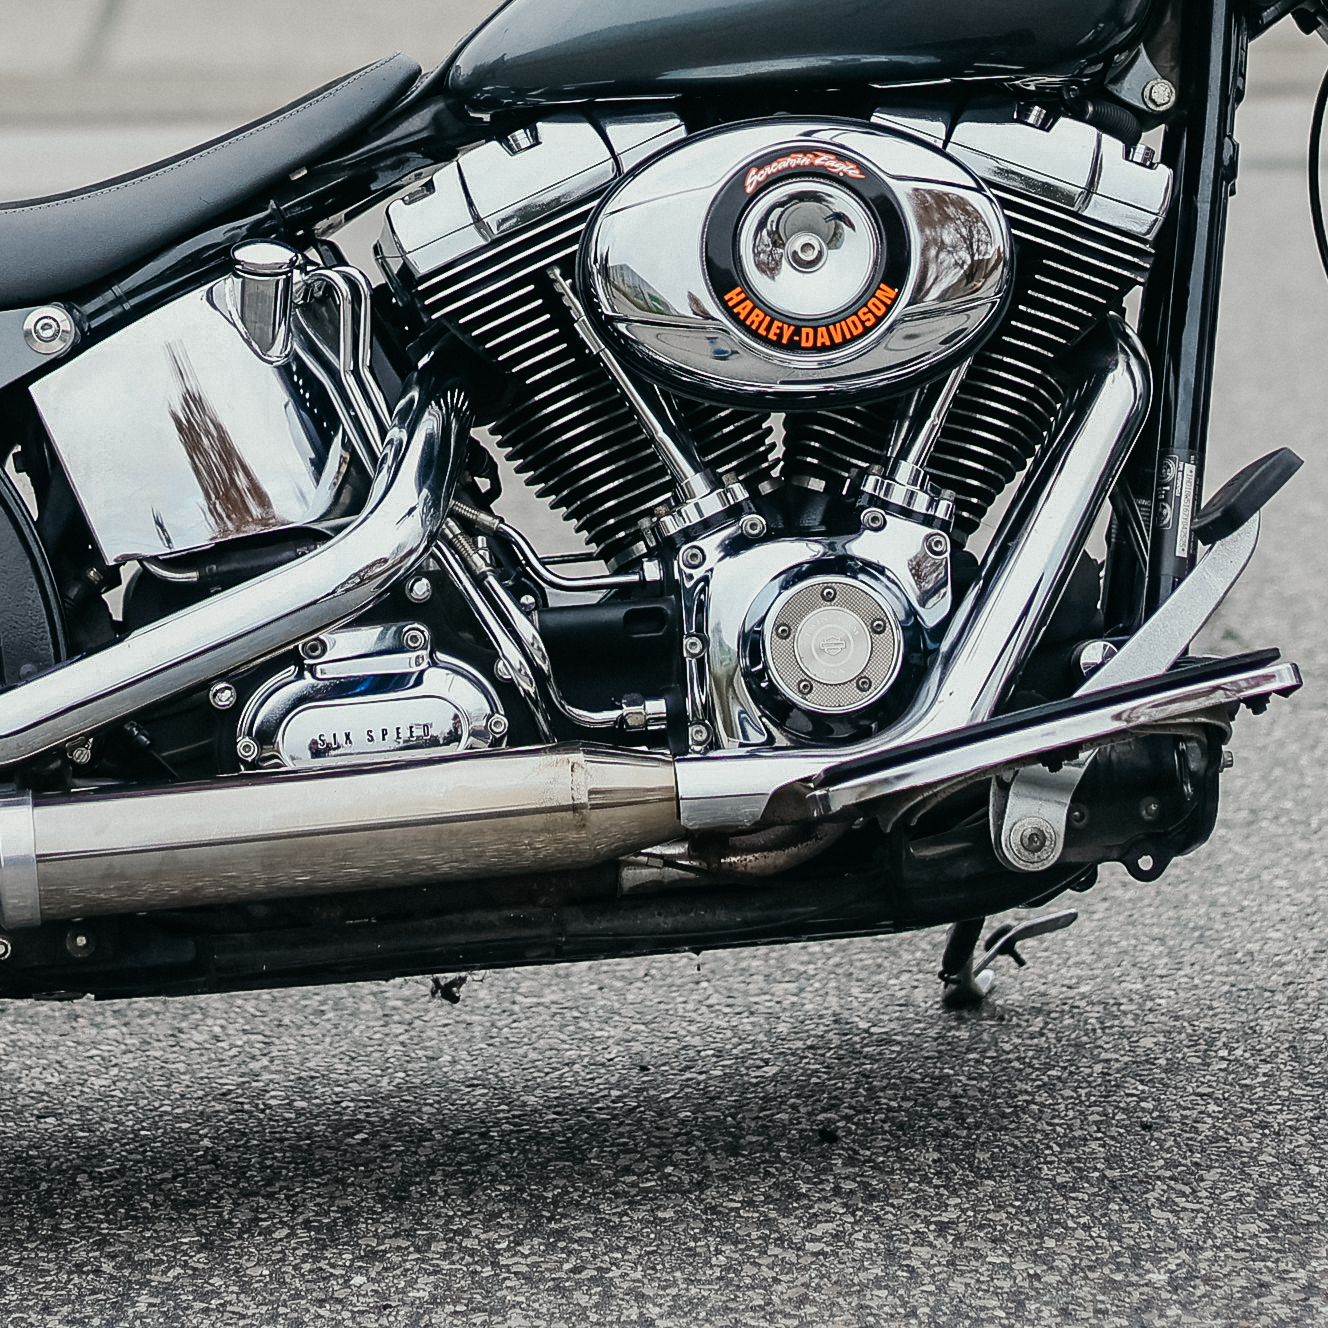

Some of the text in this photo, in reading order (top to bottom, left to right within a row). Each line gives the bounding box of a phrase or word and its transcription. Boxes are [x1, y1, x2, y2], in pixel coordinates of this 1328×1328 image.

[812, 151, 866, 179] Eagle
[723, 283, 898, 349] HARLEY-DAVIDSON
[318, 723, 433, 749] SIX SPEED
